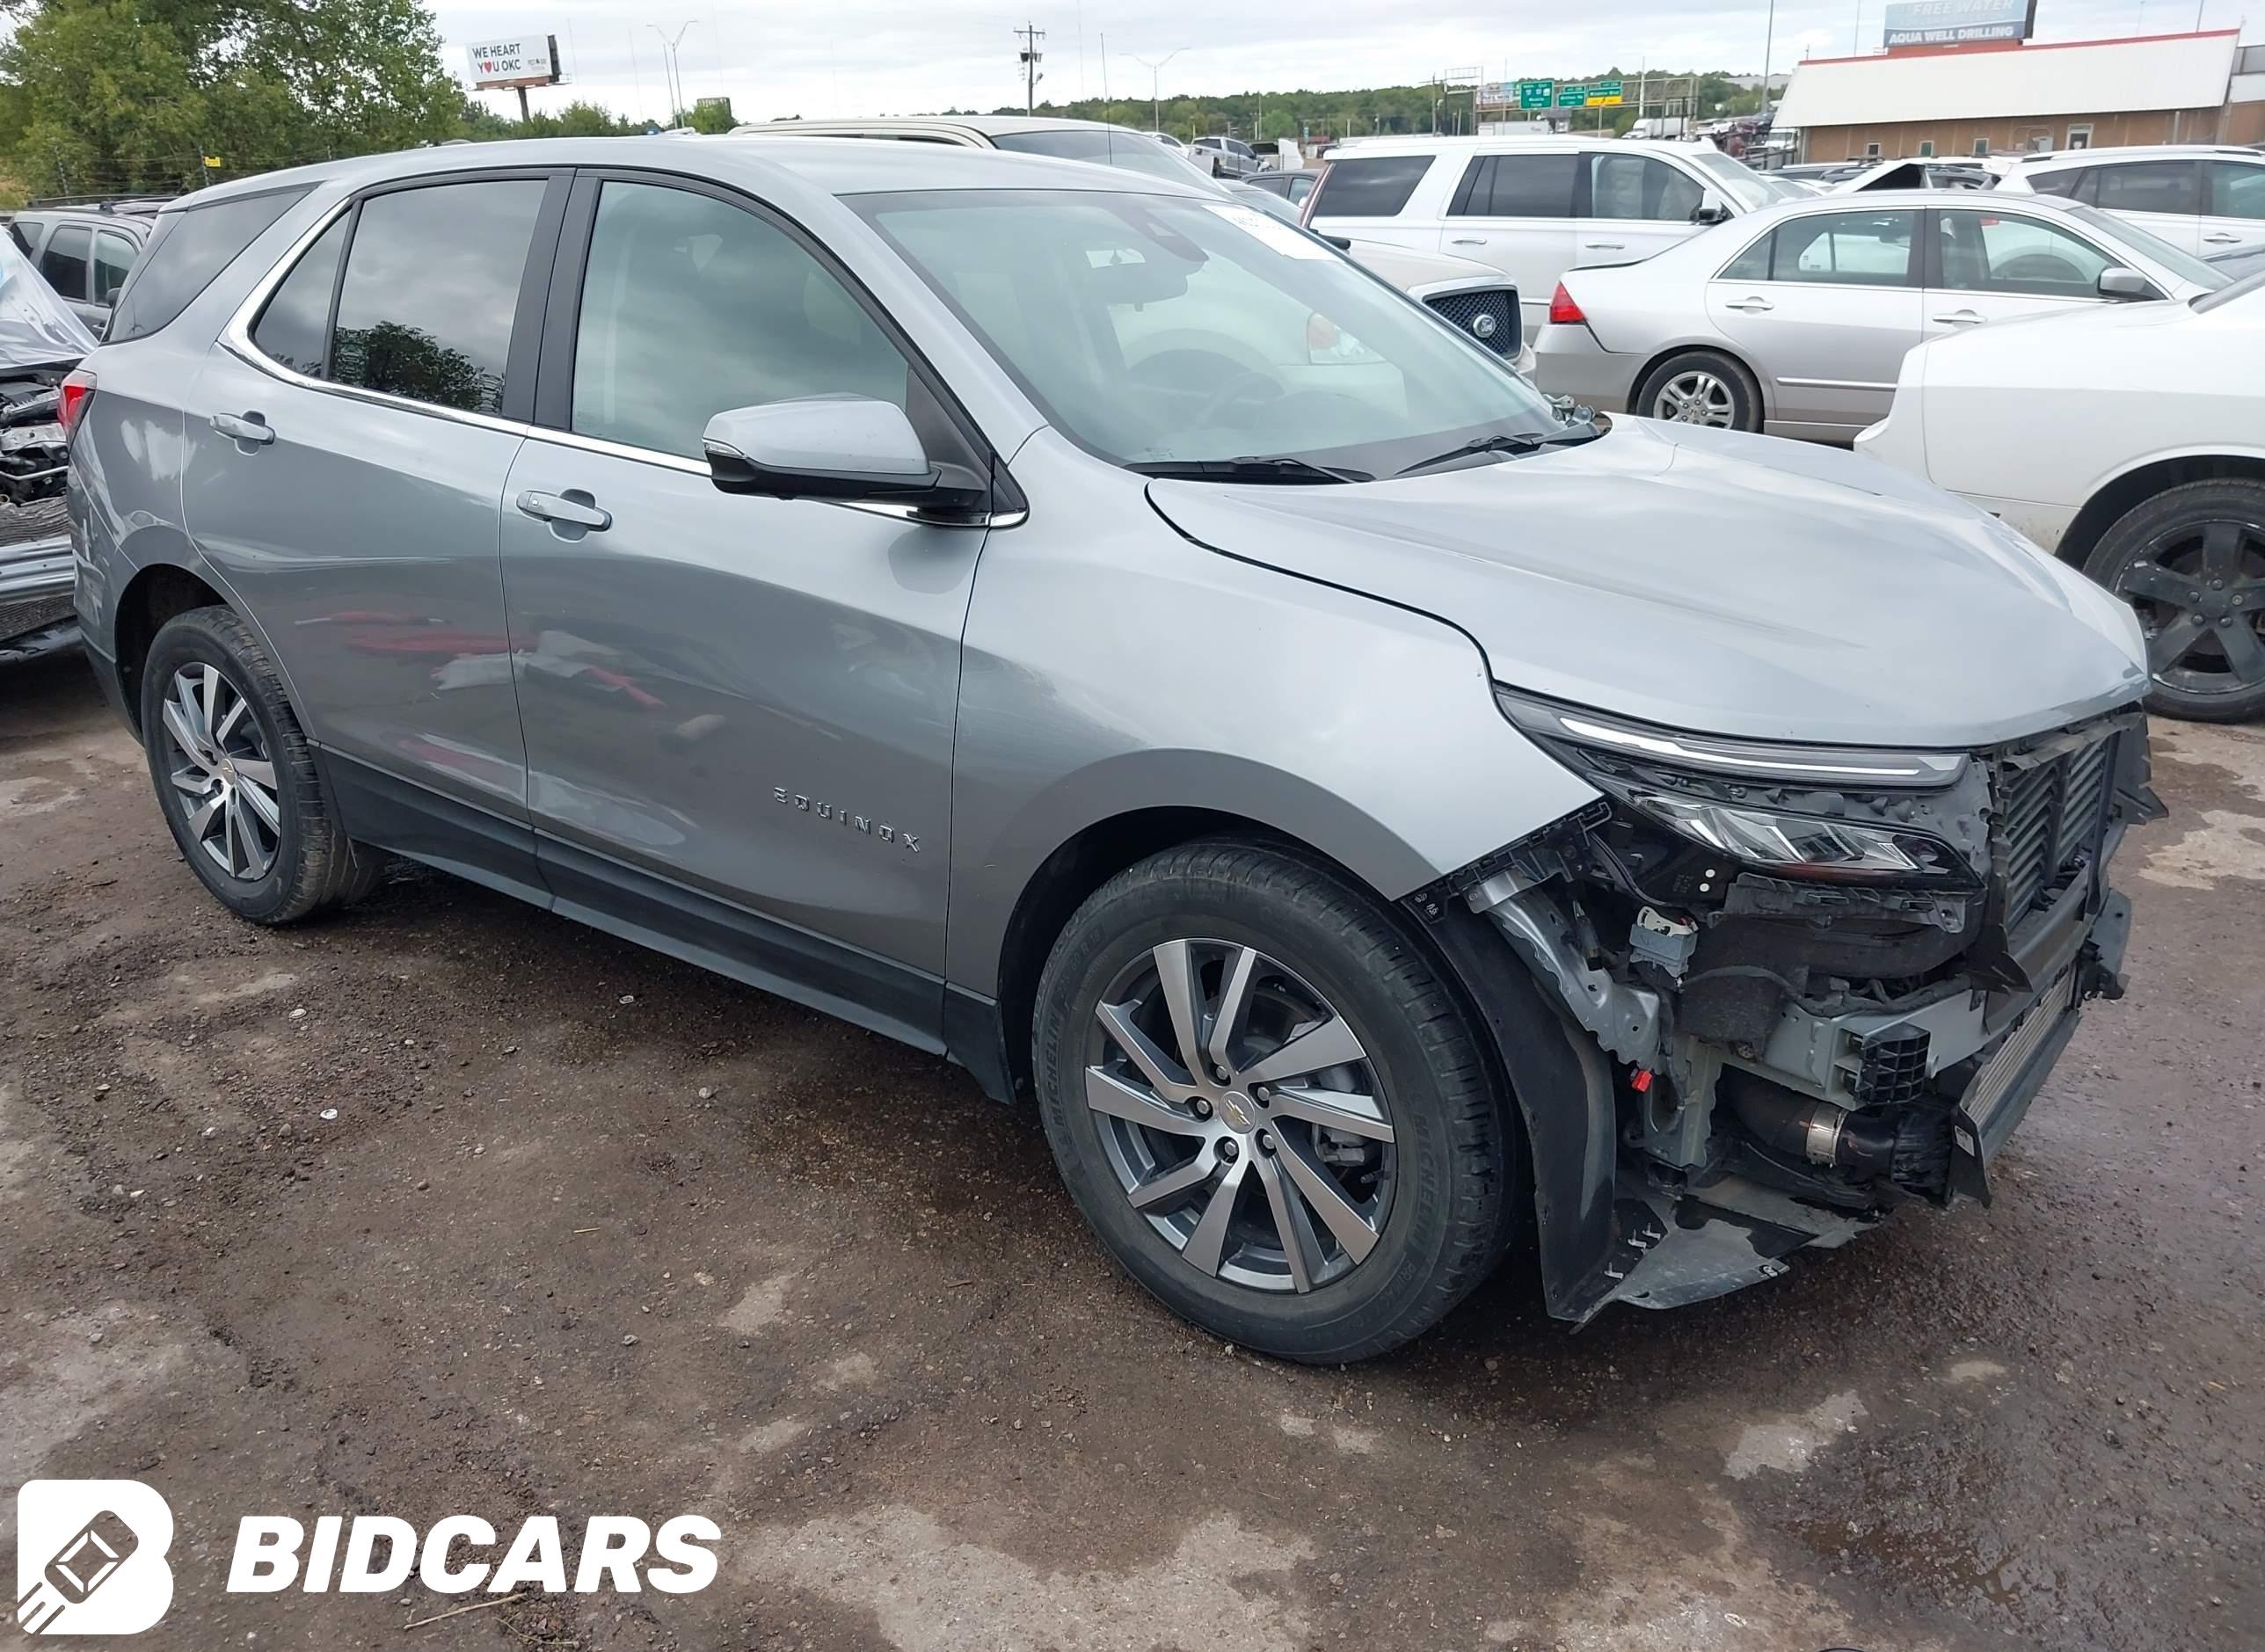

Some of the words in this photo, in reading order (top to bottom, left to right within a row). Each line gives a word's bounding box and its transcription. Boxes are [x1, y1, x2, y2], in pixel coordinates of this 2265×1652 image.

[1913, 3, 1949, 15] FREE
[1956, 0, 2013, 12] WATER
[1889, 33, 1922, 44] AQUA
[1924, 30, 1955, 41] WELL
[1957, 26, 2014, 39] DRILLING
[472, 47, 489, 59] WE
[490, 43, 521, 57] HEART
[501, 60, 521, 71] OKC
[773, 787, 920, 853] EQUINOX
[1045, 1009, 1066, 1126] MICHELIN
[1408, 1114, 1438, 1248] MICHELIN
